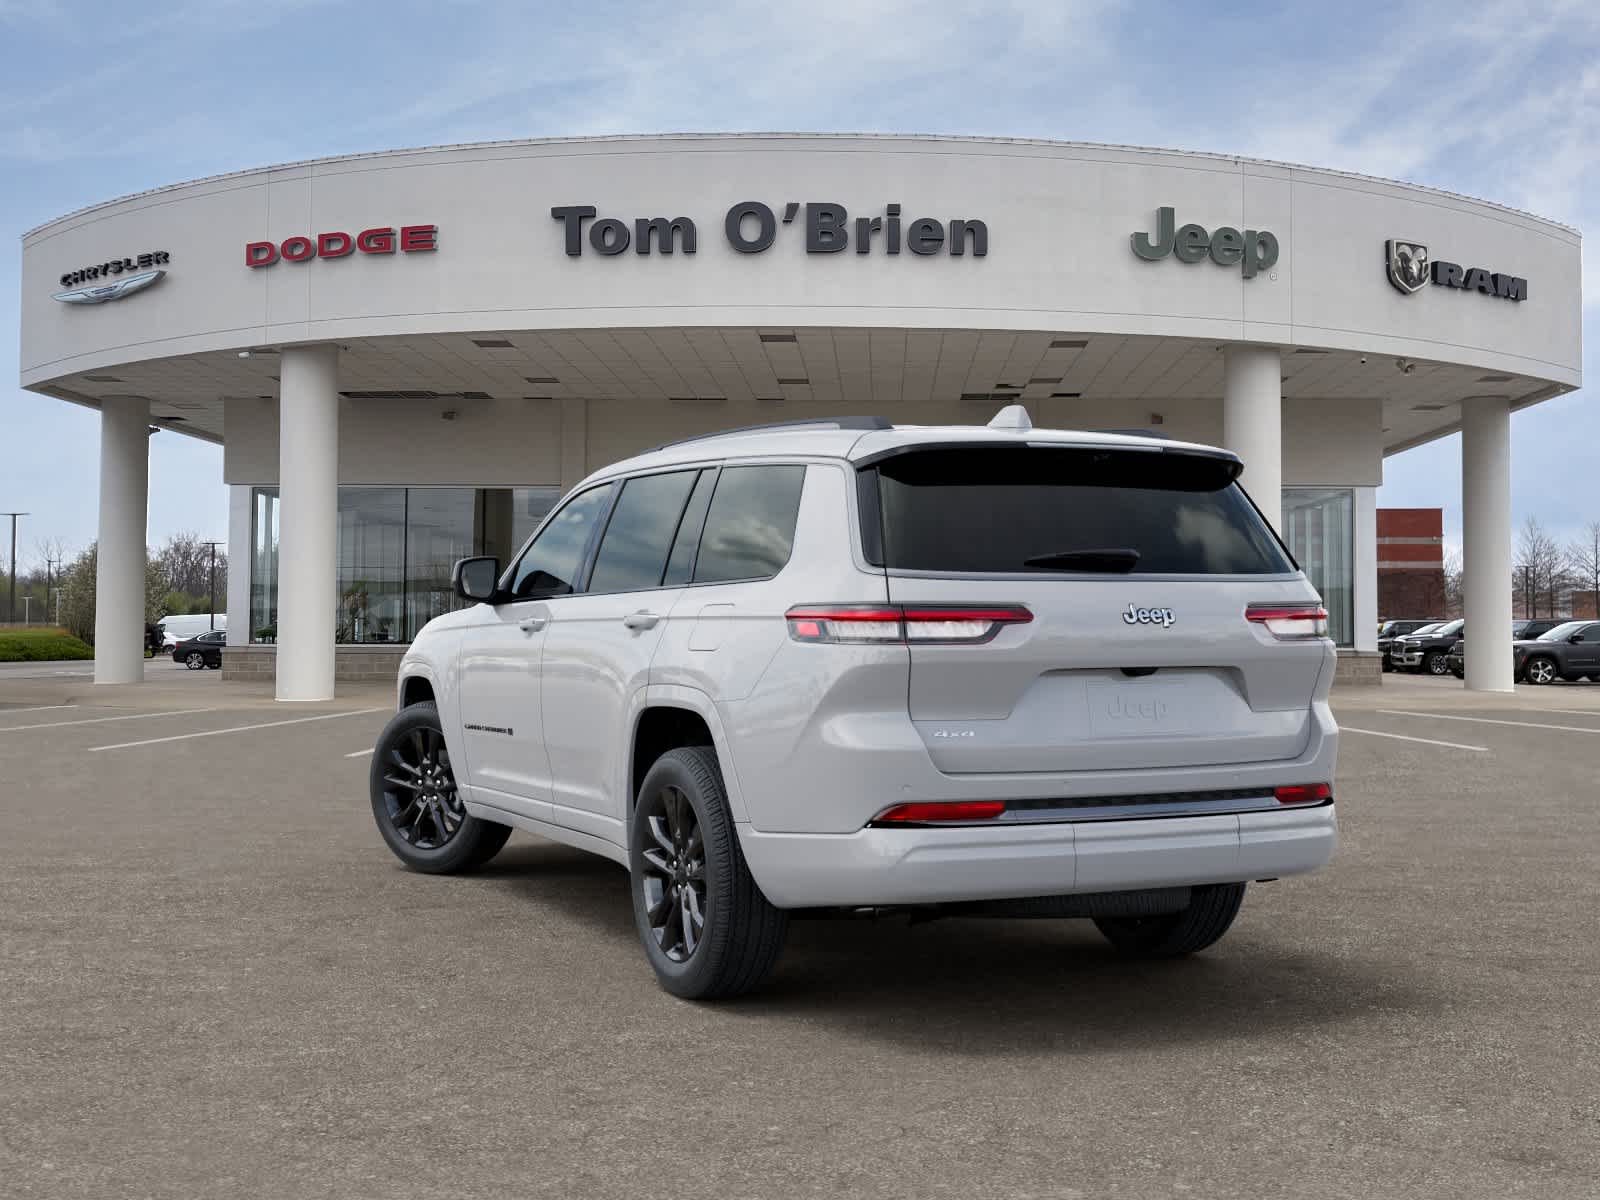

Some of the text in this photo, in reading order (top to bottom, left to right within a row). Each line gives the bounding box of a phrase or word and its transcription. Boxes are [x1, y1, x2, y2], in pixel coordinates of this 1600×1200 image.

[245, 224, 439, 269] DODGE
[551, 205, 697, 256] Tom
[1130, 206, 1280, 279] Jeep
[60, 250, 170, 287] CHRYSLER
[1431, 260, 1528, 302] RAM
[1122, 602, 1177, 629] Jeep
